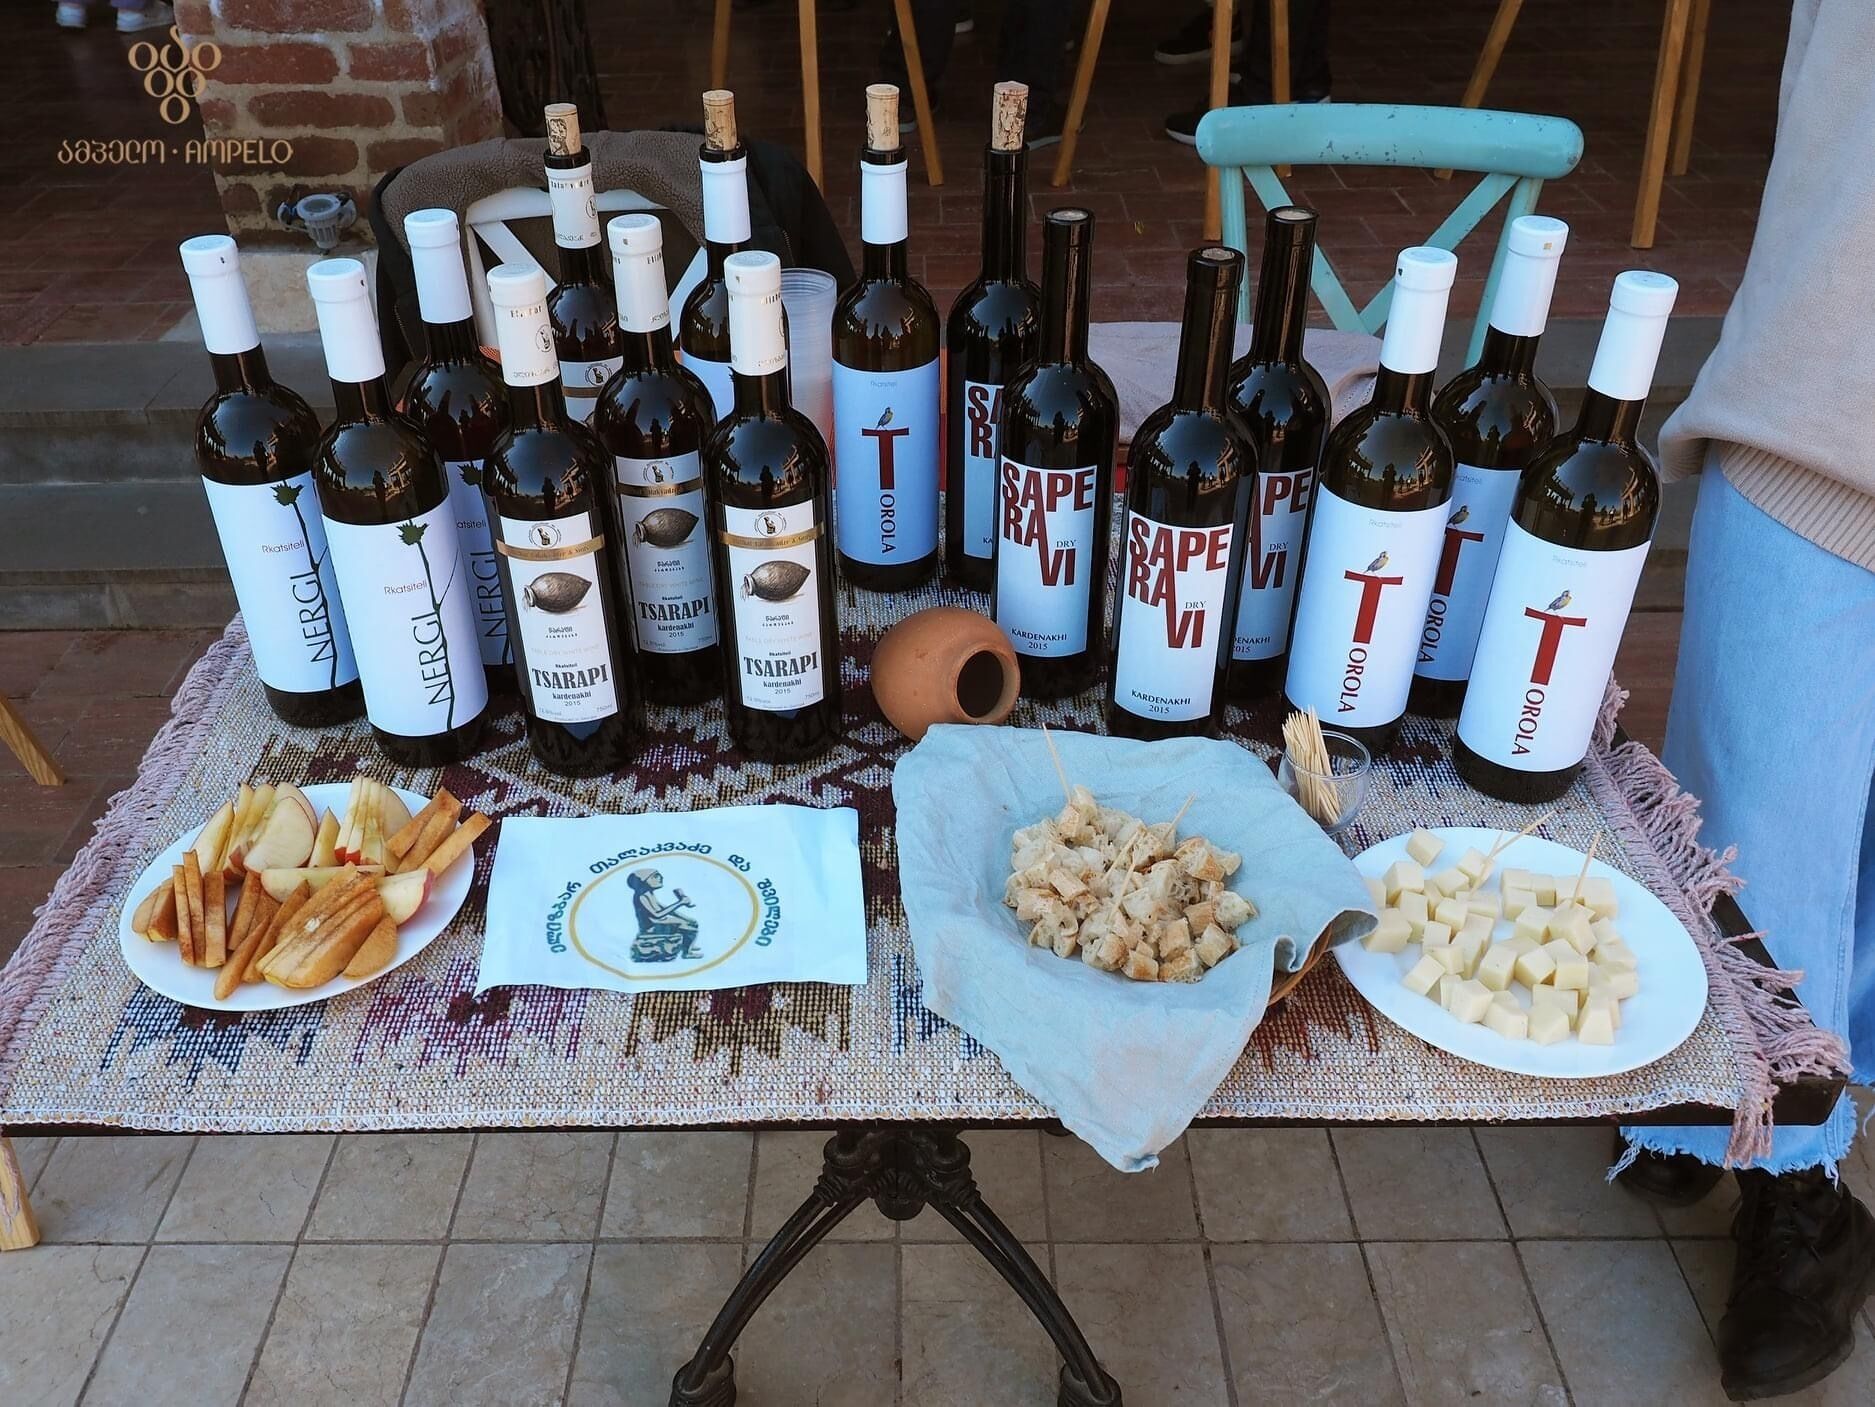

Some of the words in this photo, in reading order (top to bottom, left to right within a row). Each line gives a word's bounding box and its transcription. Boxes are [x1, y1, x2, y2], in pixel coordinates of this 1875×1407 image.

[261, 539, 305, 553] Rkatsiteli
[1056, 539, 1076, 548] DRY
[1269, 542, 1288, 550] DRY
[384, 580, 427, 595] Rkatsiteli
[639, 596, 710, 621] TSARAPI
[1185, 600, 1207, 609] DRY
[290, 569, 337, 662] NERGI
[1011, 628, 1067, 641] KARDENAKHI
[1028, 642, 1048, 650] 2015
[411, 611, 453, 705] NERGI
[744, 652, 818, 677] TSARAPI
[532, 664, 608, 689] TSARAPI
[1131, 688, 1191, 705] KARDENAKHI
[1148, 704, 1170, 714] 2015
[728, 854, 751, 872] და
